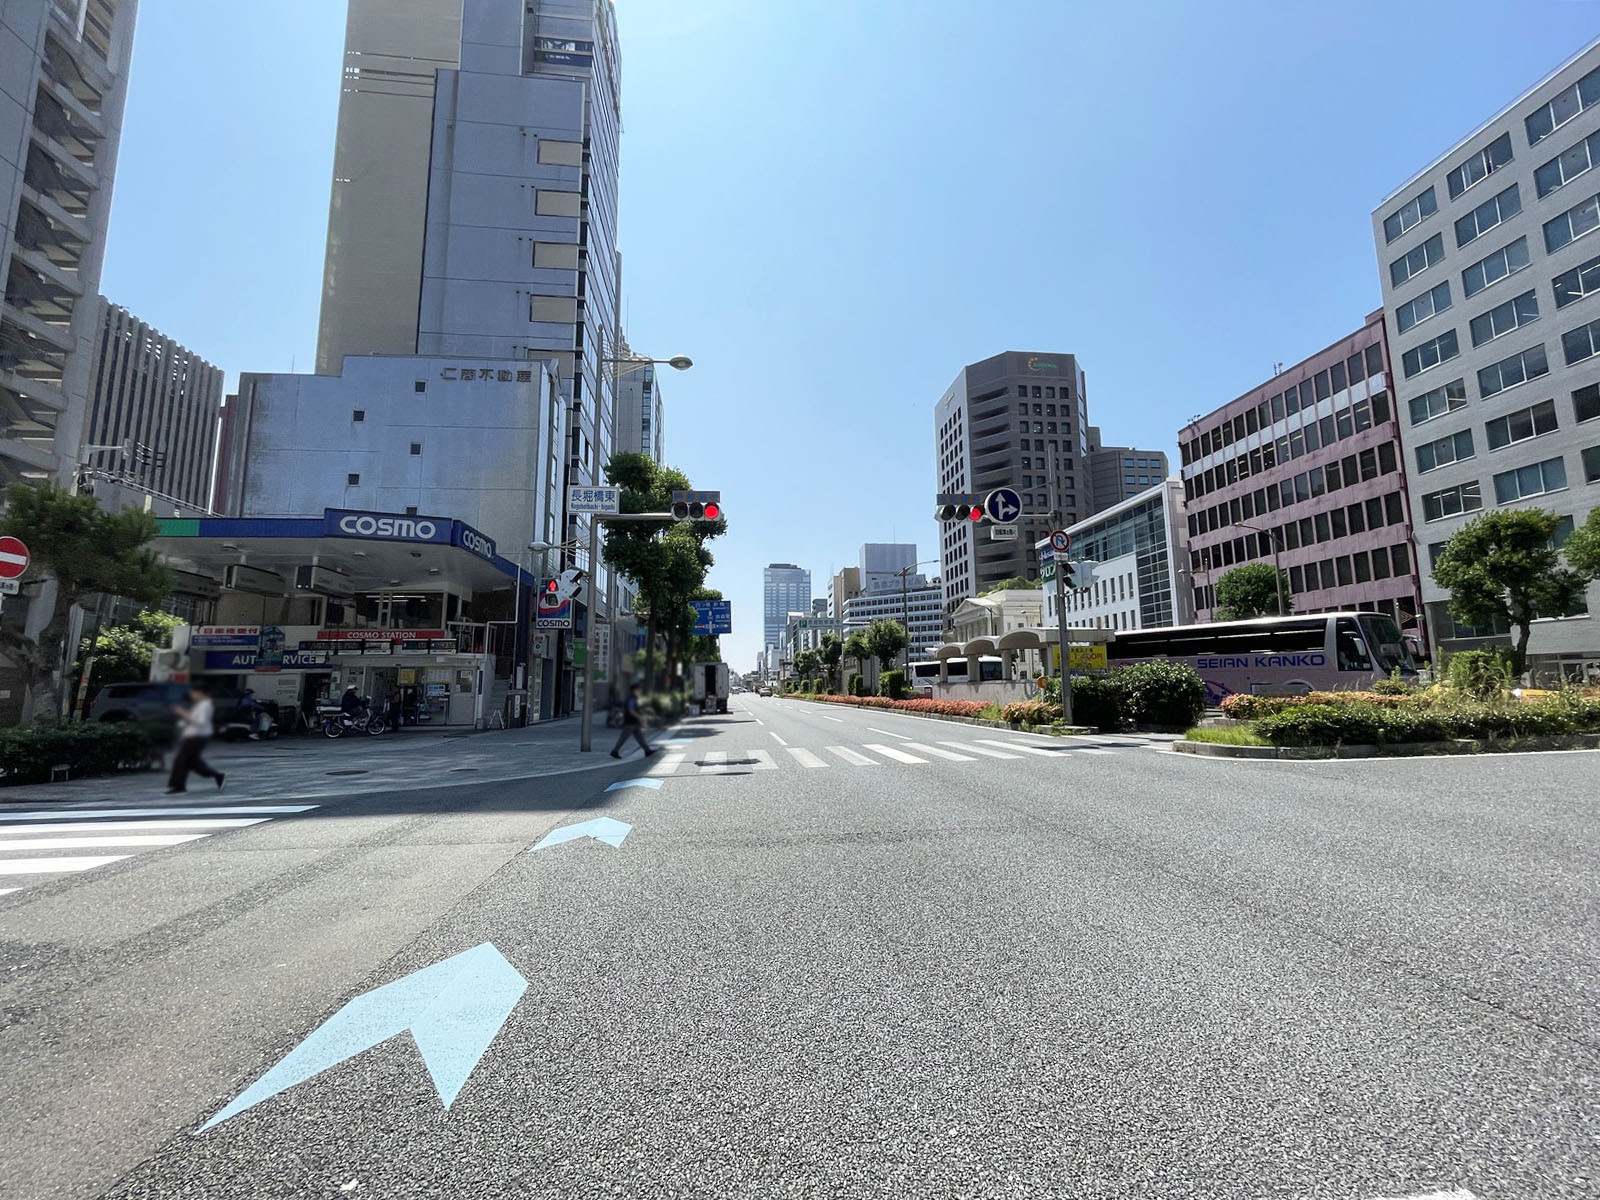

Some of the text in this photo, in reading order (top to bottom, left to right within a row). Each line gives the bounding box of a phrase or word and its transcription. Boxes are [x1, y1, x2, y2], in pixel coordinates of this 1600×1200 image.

[571, 489, 616, 502] 長堀橋東
[340, 516, 436, 539] COSMO
[463, 530, 493, 558] COSMO
[537, 620, 570, 628] COSMO
[232, 654, 317, 665] AUT RVICE
[1197, 654, 1325, 669] SEIAN KANKO
